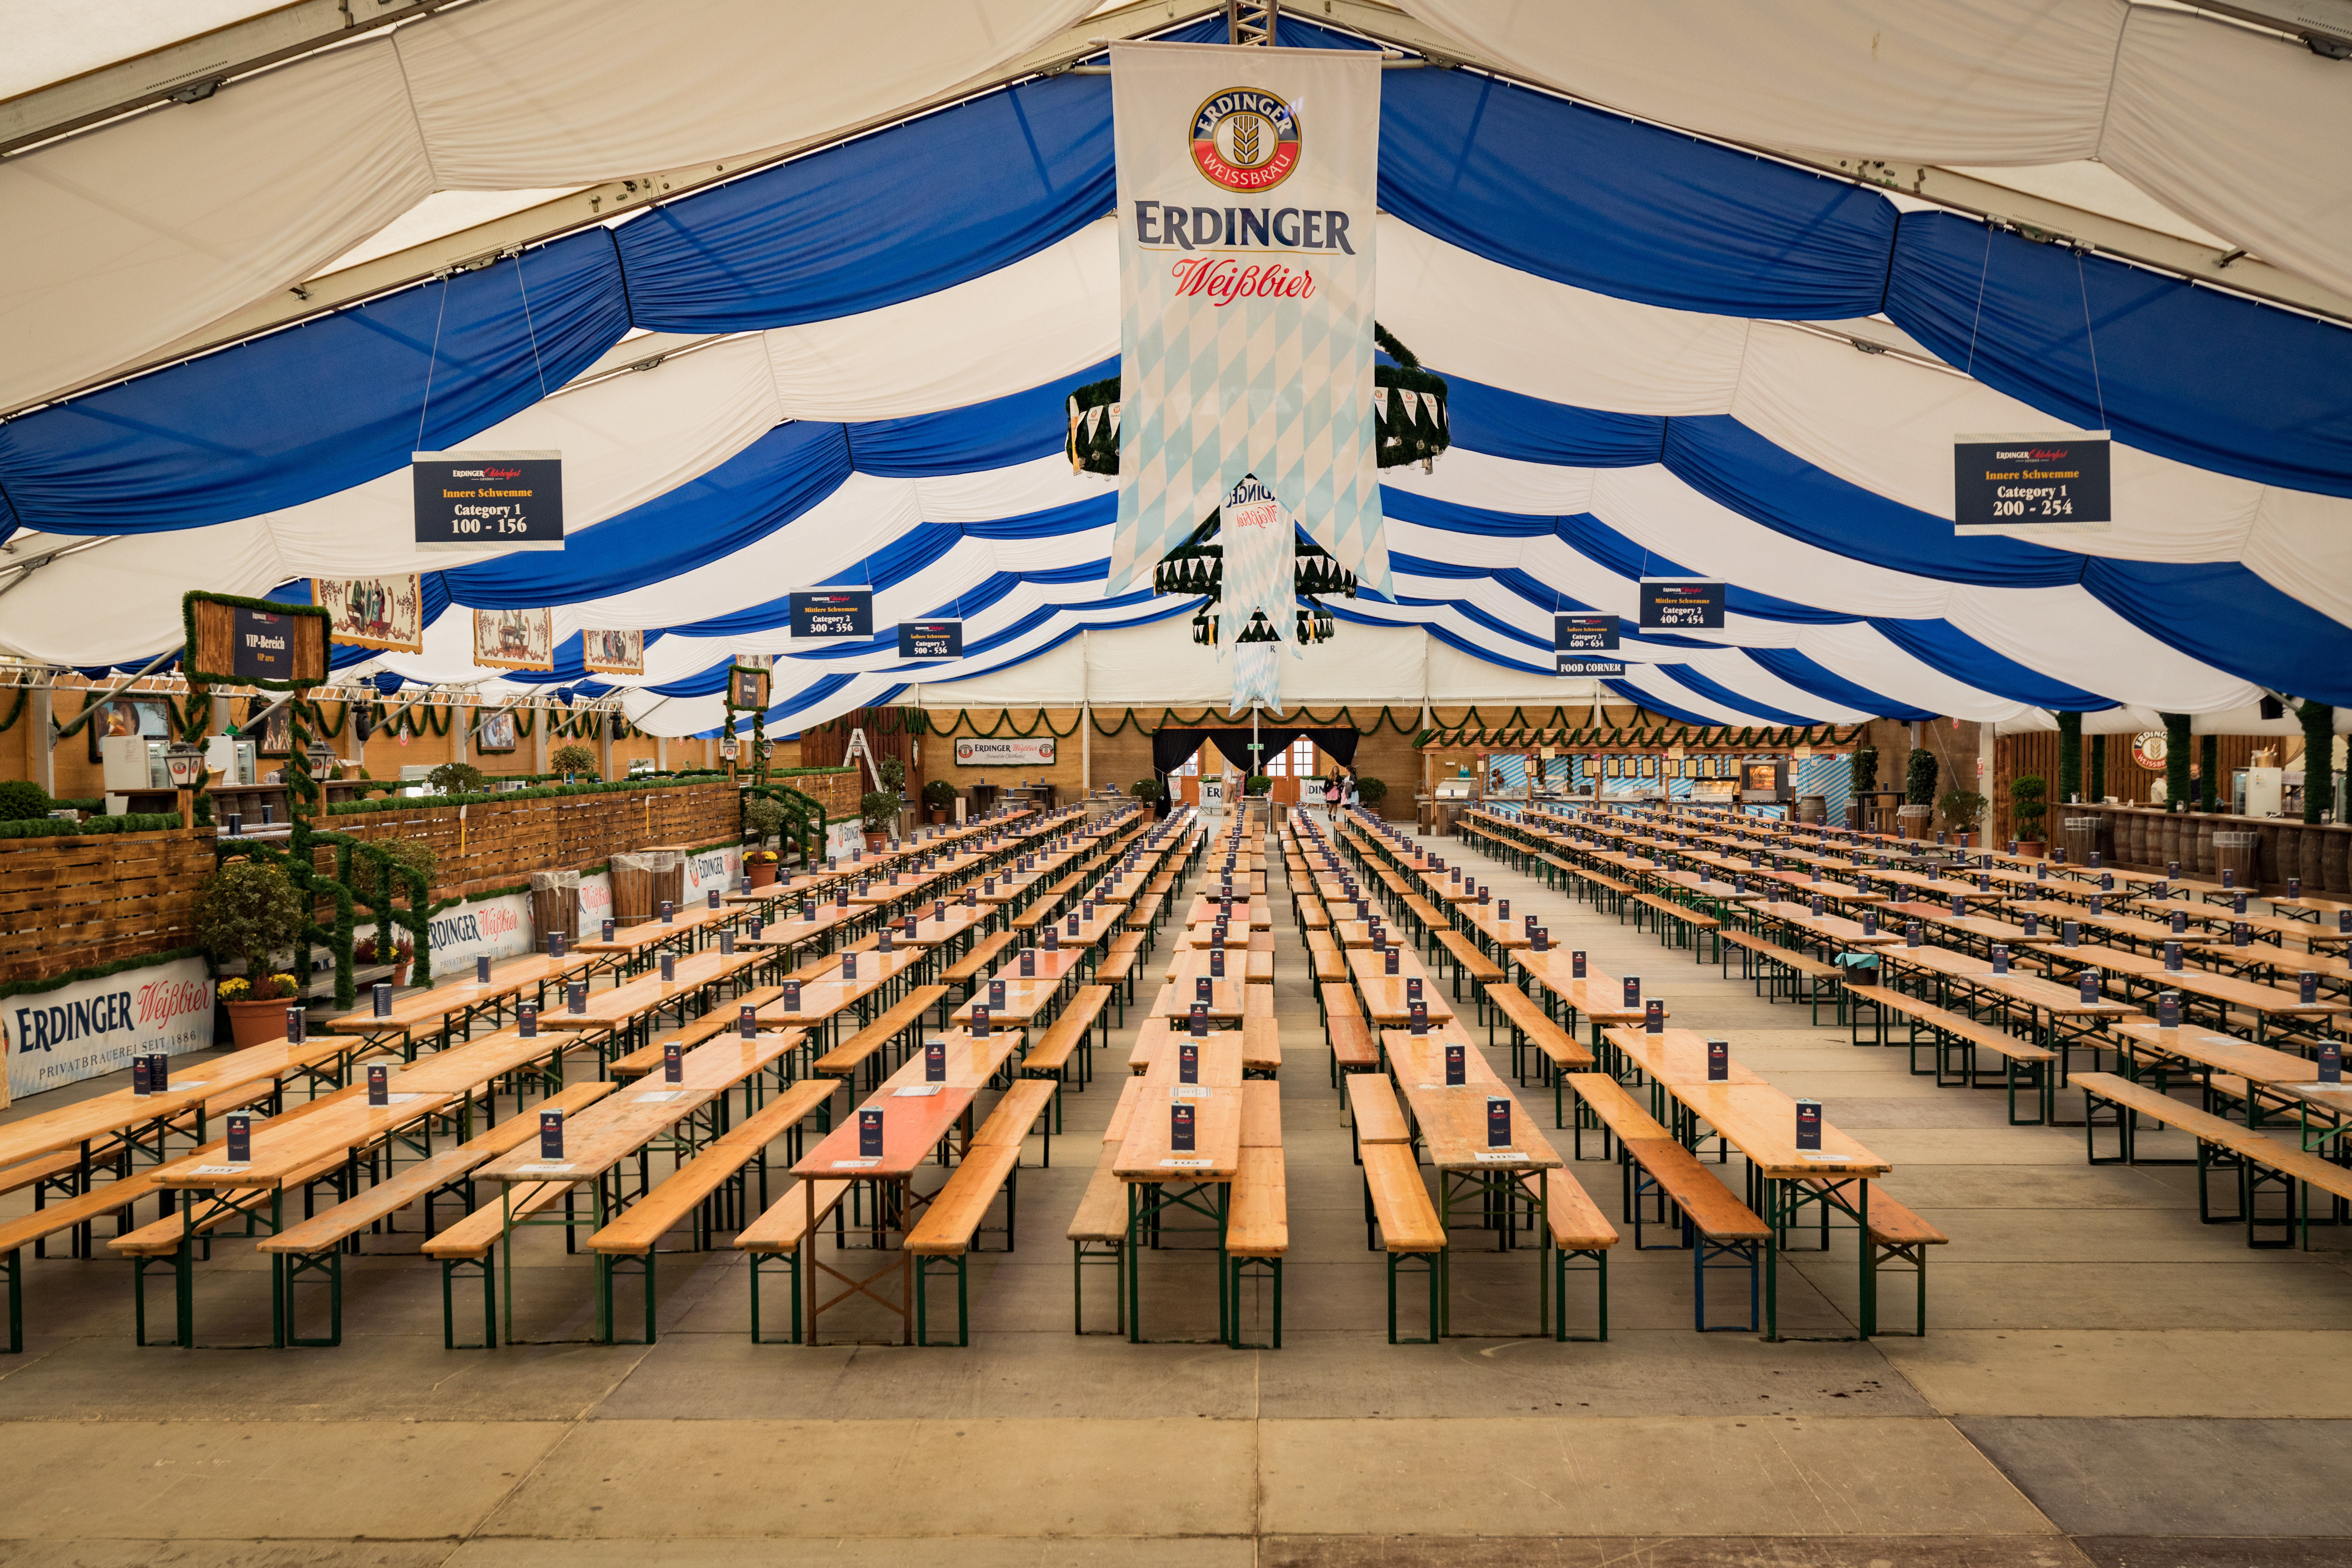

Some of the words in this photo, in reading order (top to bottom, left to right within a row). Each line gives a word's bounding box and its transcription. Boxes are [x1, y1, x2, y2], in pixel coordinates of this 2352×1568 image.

[1197, 93, 1292, 135] ERDINGER
[1204, 152, 1291, 185] WEISSBRÄU
[1134, 200, 1356, 255] ERDINGER
[1172, 257, 1316, 307] Weißbier
[483, 467, 521, 480] Oktoberfest
[1986, 470, 2020, 480] Innere
[2022, 469, 2079, 479] Schwemme
[443, 489, 475, 498] Innere
[478, 488, 532, 498] Schwemme
[1997, 486, 2056, 500] Category
[2060, 485, 2066, 496] 1
[455, 504, 510, 518] Category
[514, 503, 521, 514] 1
[1993, 501, 2024, 516] 200
[2042, 498, 2073, 516] 254
[451, 519, 481, 533] 100
[498, 517, 527, 534] 156
[1663, 607, 1695, 615] Category
[1661, 614, 1677, 623] 400
[1687, 614, 1704, 624] 454
[810, 624, 827, 633] 300
[836, 622, 853, 632] 356
[246, 634, 285, 649] VIP-Bereich
[1561, 664, 1584, 672] FOOD
[1586, 663, 1621, 672] CORNER
[2135, 731, 2167, 747] ERDING
[974, 744, 1011, 752] ERDINGER
[1012, 744, 1037, 753] Weißbier
[478, 908, 518, 941] Weißbier
[487, 947, 499, 956] SEIT
[15, 991, 135, 1054] ERDINGER
[137, 980, 210, 1030] Weißbier
[39, 1044, 137, 1080] PRIVATBRAUEREI
[142, 1037, 165, 1052] SEIT
[171, 1030, 196, 1046] 1886
